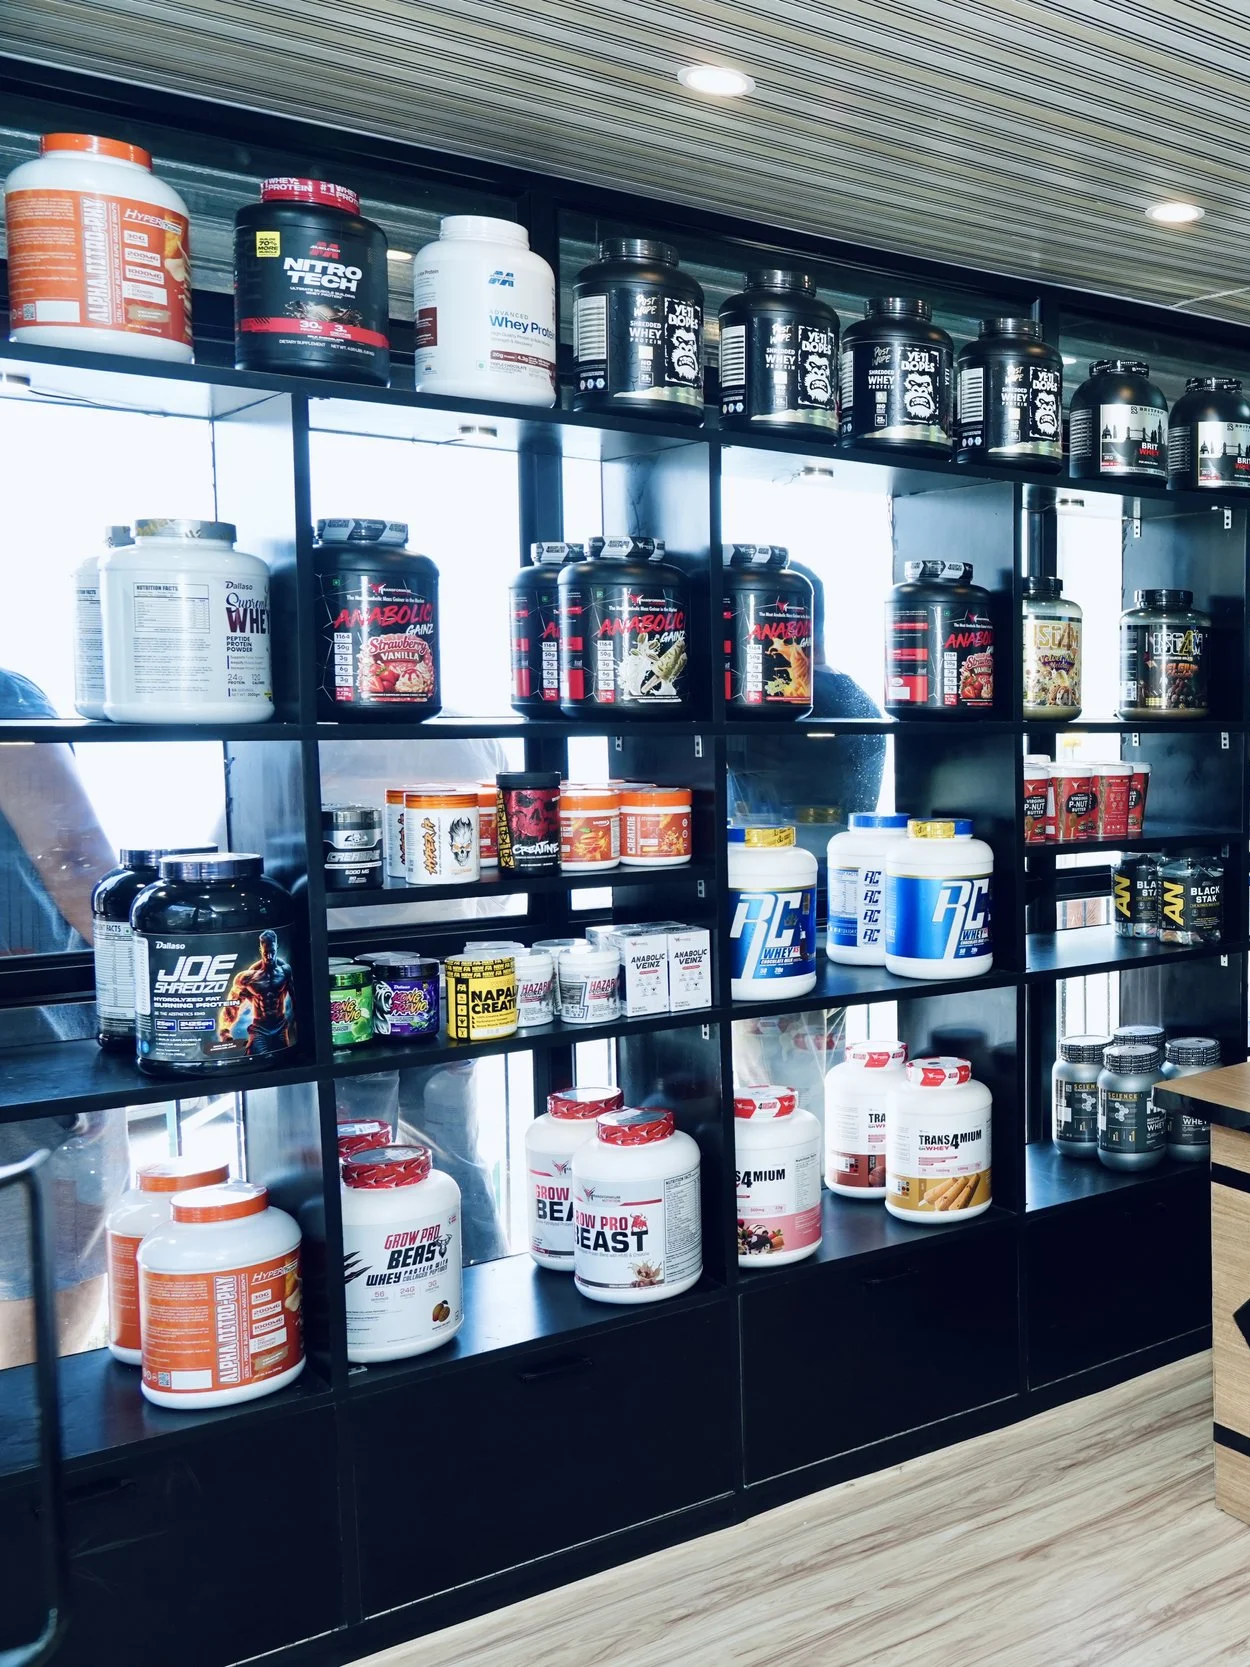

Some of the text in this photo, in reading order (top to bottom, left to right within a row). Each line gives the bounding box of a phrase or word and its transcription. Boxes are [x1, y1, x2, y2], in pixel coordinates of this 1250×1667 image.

[268, 184, 313, 192] PROTEIN
[335, 184, 357, 198] WHEY
[283, 257, 363, 280] NITRO
[287, 270, 359, 292] TECH
[86, 278, 111, 324] ALPHA
[674, 304, 695, 320] YETI
[489, 315, 529, 334] Whey
[630, 320, 662, 329] SHREDDED
[668, 315, 699, 330] DOPES
[629, 328, 662, 340] WHEY
[807, 331, 827, 345] YETI
[630, 337, 662, 345] PROTEIN
[766, 347, 795, 355] SHREDDED
[802, 341, 832, 355] DOPES
[765, 354, 796, 365] WHEY
[907, 351, 929, 363] YETI
[901, 361, 935, 373] DOPES
[868, 375, 895, 385] WHEY
[1037, 371, 1054, 383] YETI
[1032, 379, 1058, 392] DOPES
[1001, 393, 1028, 402] WHEY
[1139, 407, 1165, 415] BRITPRO
[1141, 441, 1159, 450] BRIT
[1139, 448, 1160, 456] WHEY
[225, 580, 253, 590] Dallaso
[333, 603, 433, 629] ANABOLIC
[406, 624, 434, 636] GAINZ
[598, 611, 685, 637] ANABOLIC
[660, 631, 686, 643] GAINZ
[368, 636, 427, 655] Strawberry
[380, 652, 419, 660] VANILLA
[1024, 803, 1046, 811] P-NUT
[1068, 801, 1088, 809] P-NUT
[626, 816, 636, 855] CREATINE
[423, 831, 438, 876] HYPER
[512, 841, 560, 855] CREATINE
[864, 871, 882, 885] RC
[1190, 885, 1220, 896] BLACK
[863, 890, 882, 904] RC
[1195, 895, 1217, 903] STAK
[863, 909, 882, 923] RC
[932, 878, 989, 960] RC
[106, 925, 121, 933] FACTS
[962, 930, 983, 940] WHEY
[729, 892, 802, 979] RC
[862, 928, 881, 943] RC
[155, 941, 186, 950] Dallaso
[630, 953, 666, 964] ANABOLIC
[674, 948, 708, 959] ANABOLIC
[763, 947, 794, 959] WHEY
[636, 961, 661, 970] VEINZ
[679, 956, 703, 965] VEINZ
[157, 953, 239, 982] JOE
[154, 981, 229, 994] SHREDZO
[391, 990, 422, 1004] KONG
[196, 1000, 240, 1009] PROTEIN
[391, 1001, 429, 1015] PREVIO
[1147, 1122, 1165, 1131] WHEY
[918, 1129, 982, 1149] TRANS4MIUM
[735, 1168, 786, 1188] S4MIUM
[535, 1184, 569, 1201] GROW
[600, 1213, 628, 1231] PRO
[384, 1224, 441, 1250] GROW PRO
[366, 1258, 449, 1287] WHEY PROTEIN WITH
[428, 1280, 438, 1288] 3G
[400, 1286, 416, 1295] 24G
[215, 1276, 240, 1384] ALPHA NITRO-PHY
